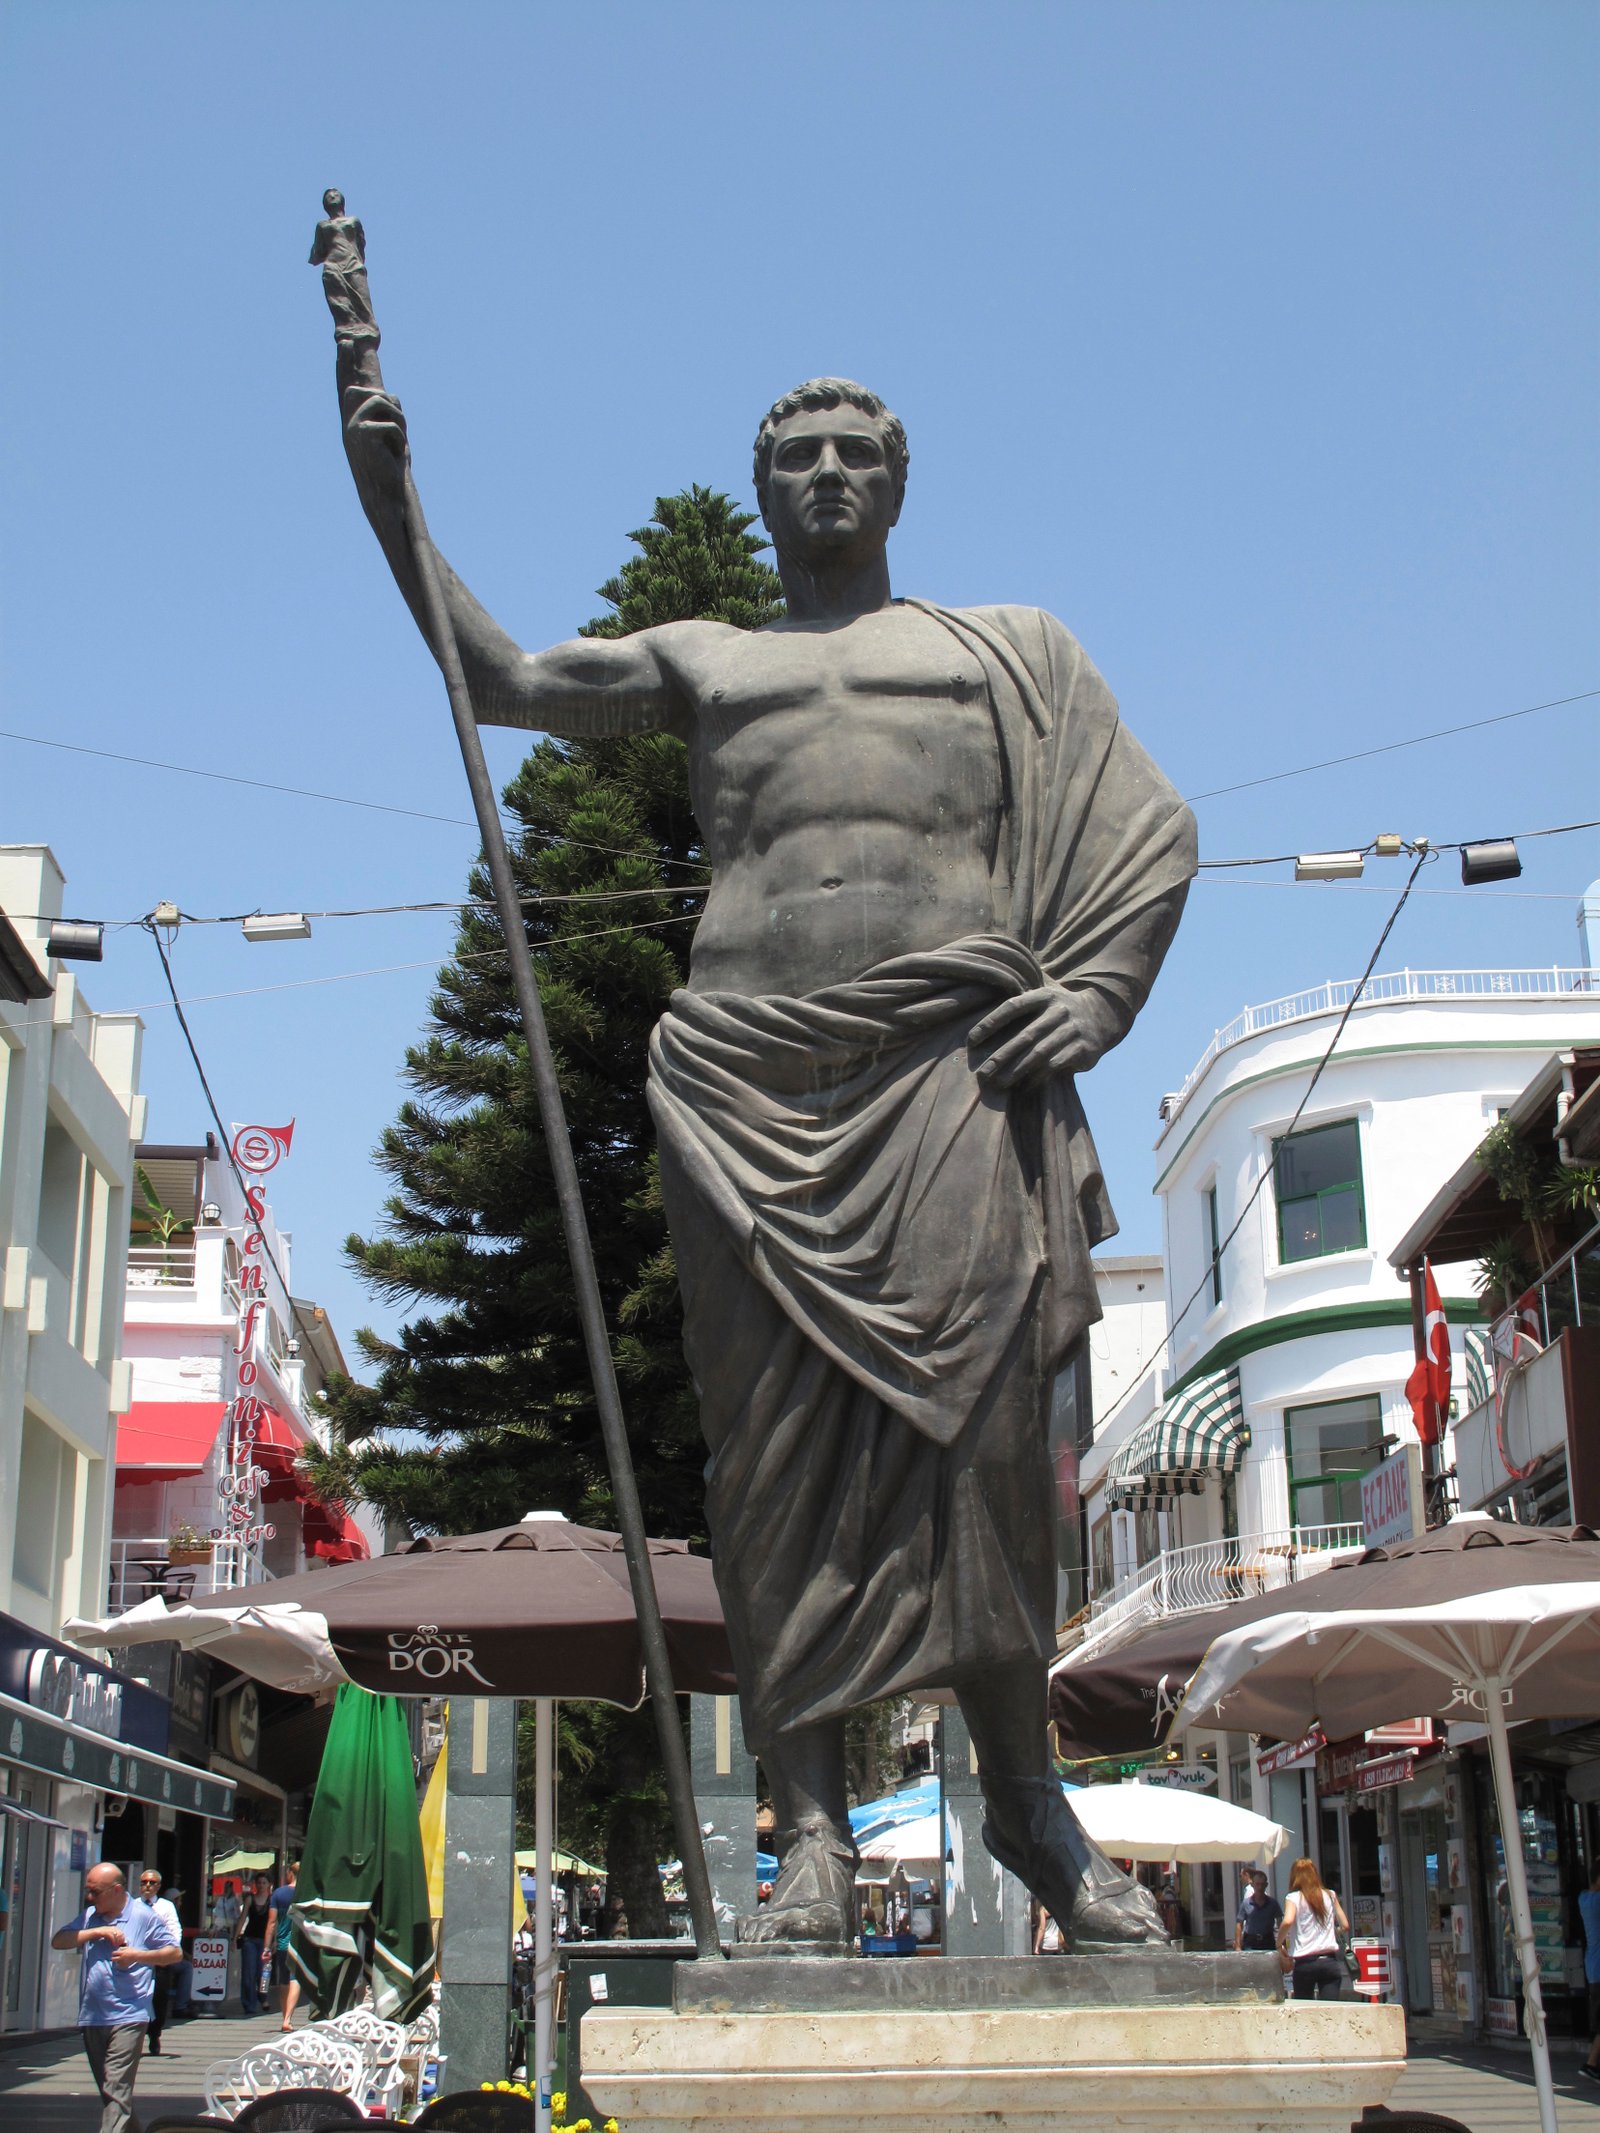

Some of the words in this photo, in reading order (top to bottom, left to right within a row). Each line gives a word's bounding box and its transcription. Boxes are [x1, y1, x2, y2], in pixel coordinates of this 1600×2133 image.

[232, 1185, 267, 1465] Senfoni
[218, 1465, 270, 1499] Cafe
[1362, 1459, 1408, 1536] ECZANE
[387, 1632, 472, 1649] CARTE
[388, 1646, 496, 1687] D'OR
[1140, 1687, 1156, 1700] The
[200, 1943, 224, 1954] OLD
[192, 1958, 227, 1969] BAZAAR
